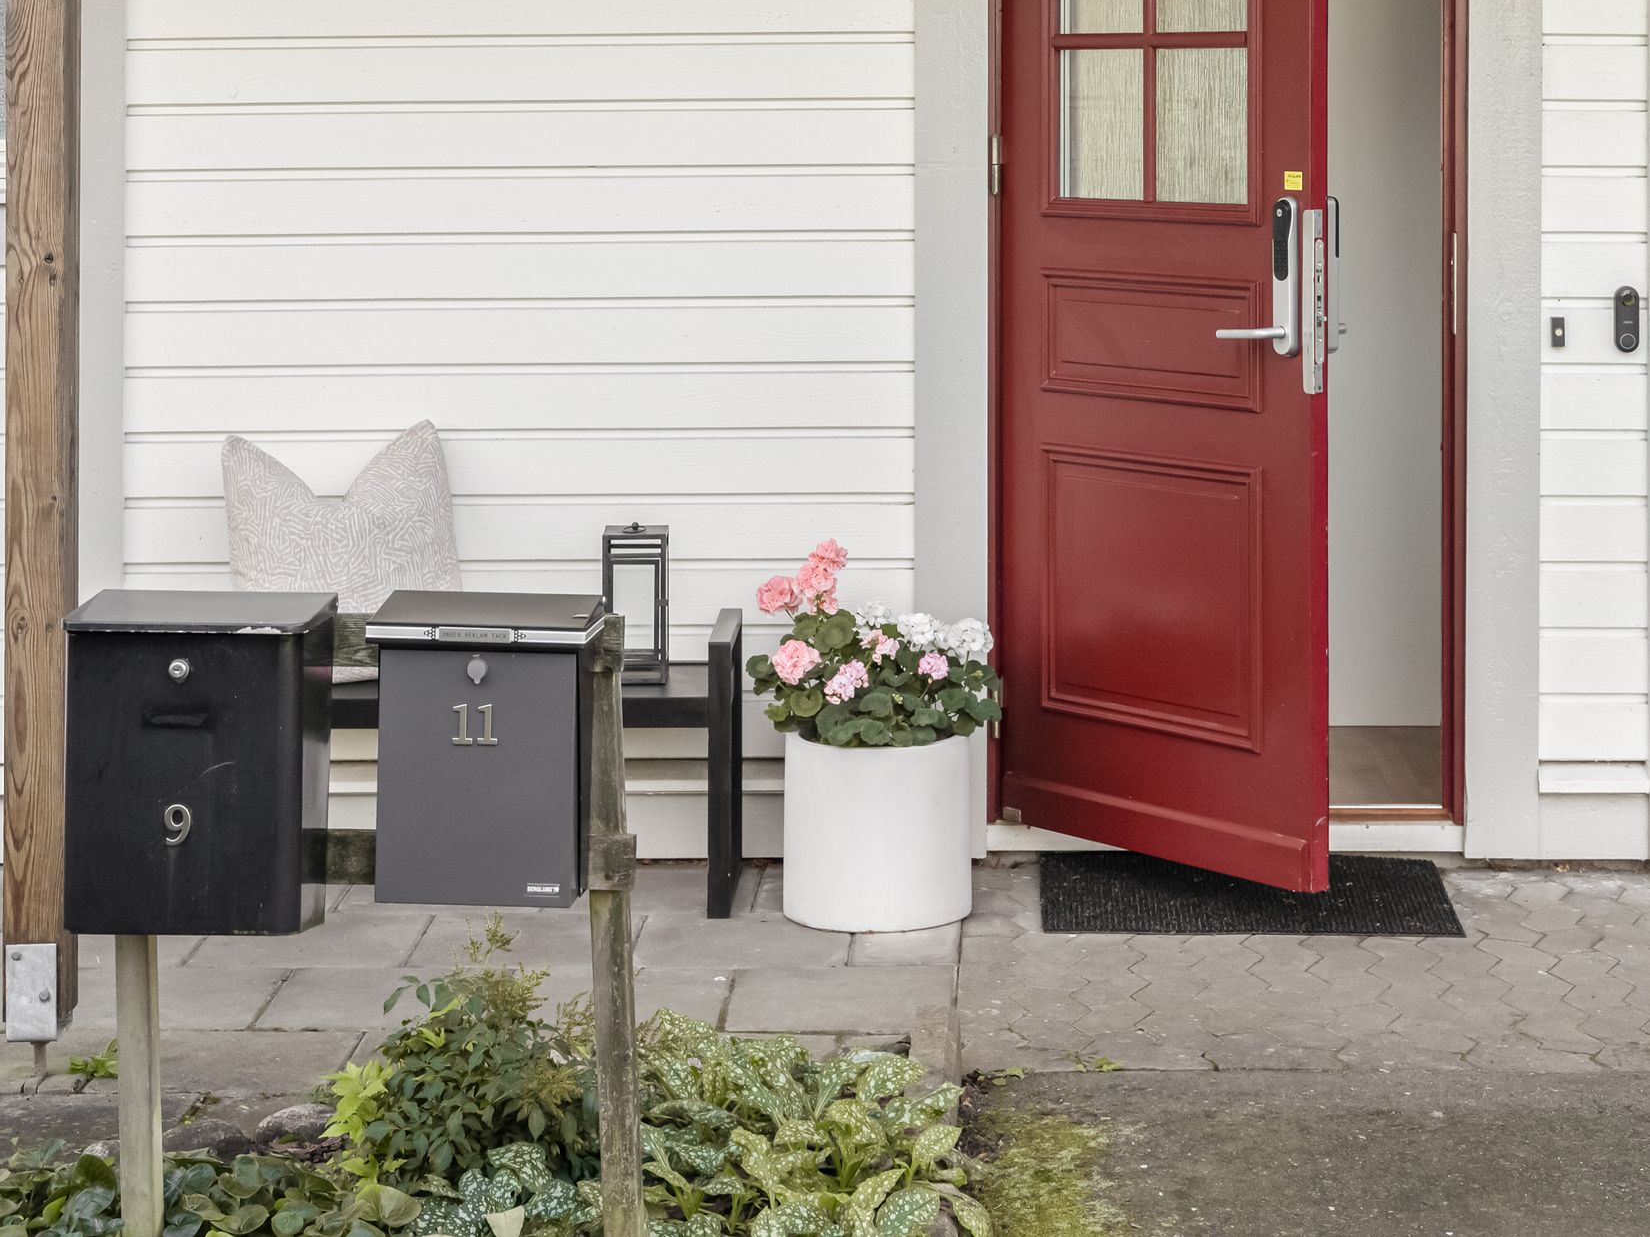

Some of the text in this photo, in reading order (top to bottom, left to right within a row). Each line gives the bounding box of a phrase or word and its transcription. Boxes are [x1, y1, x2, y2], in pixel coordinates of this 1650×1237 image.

[442, 630, 507, 640] INGEN REKLAM TACK
[452, 703, 498, 746] 11
[164, 803, 191, 845] 9
